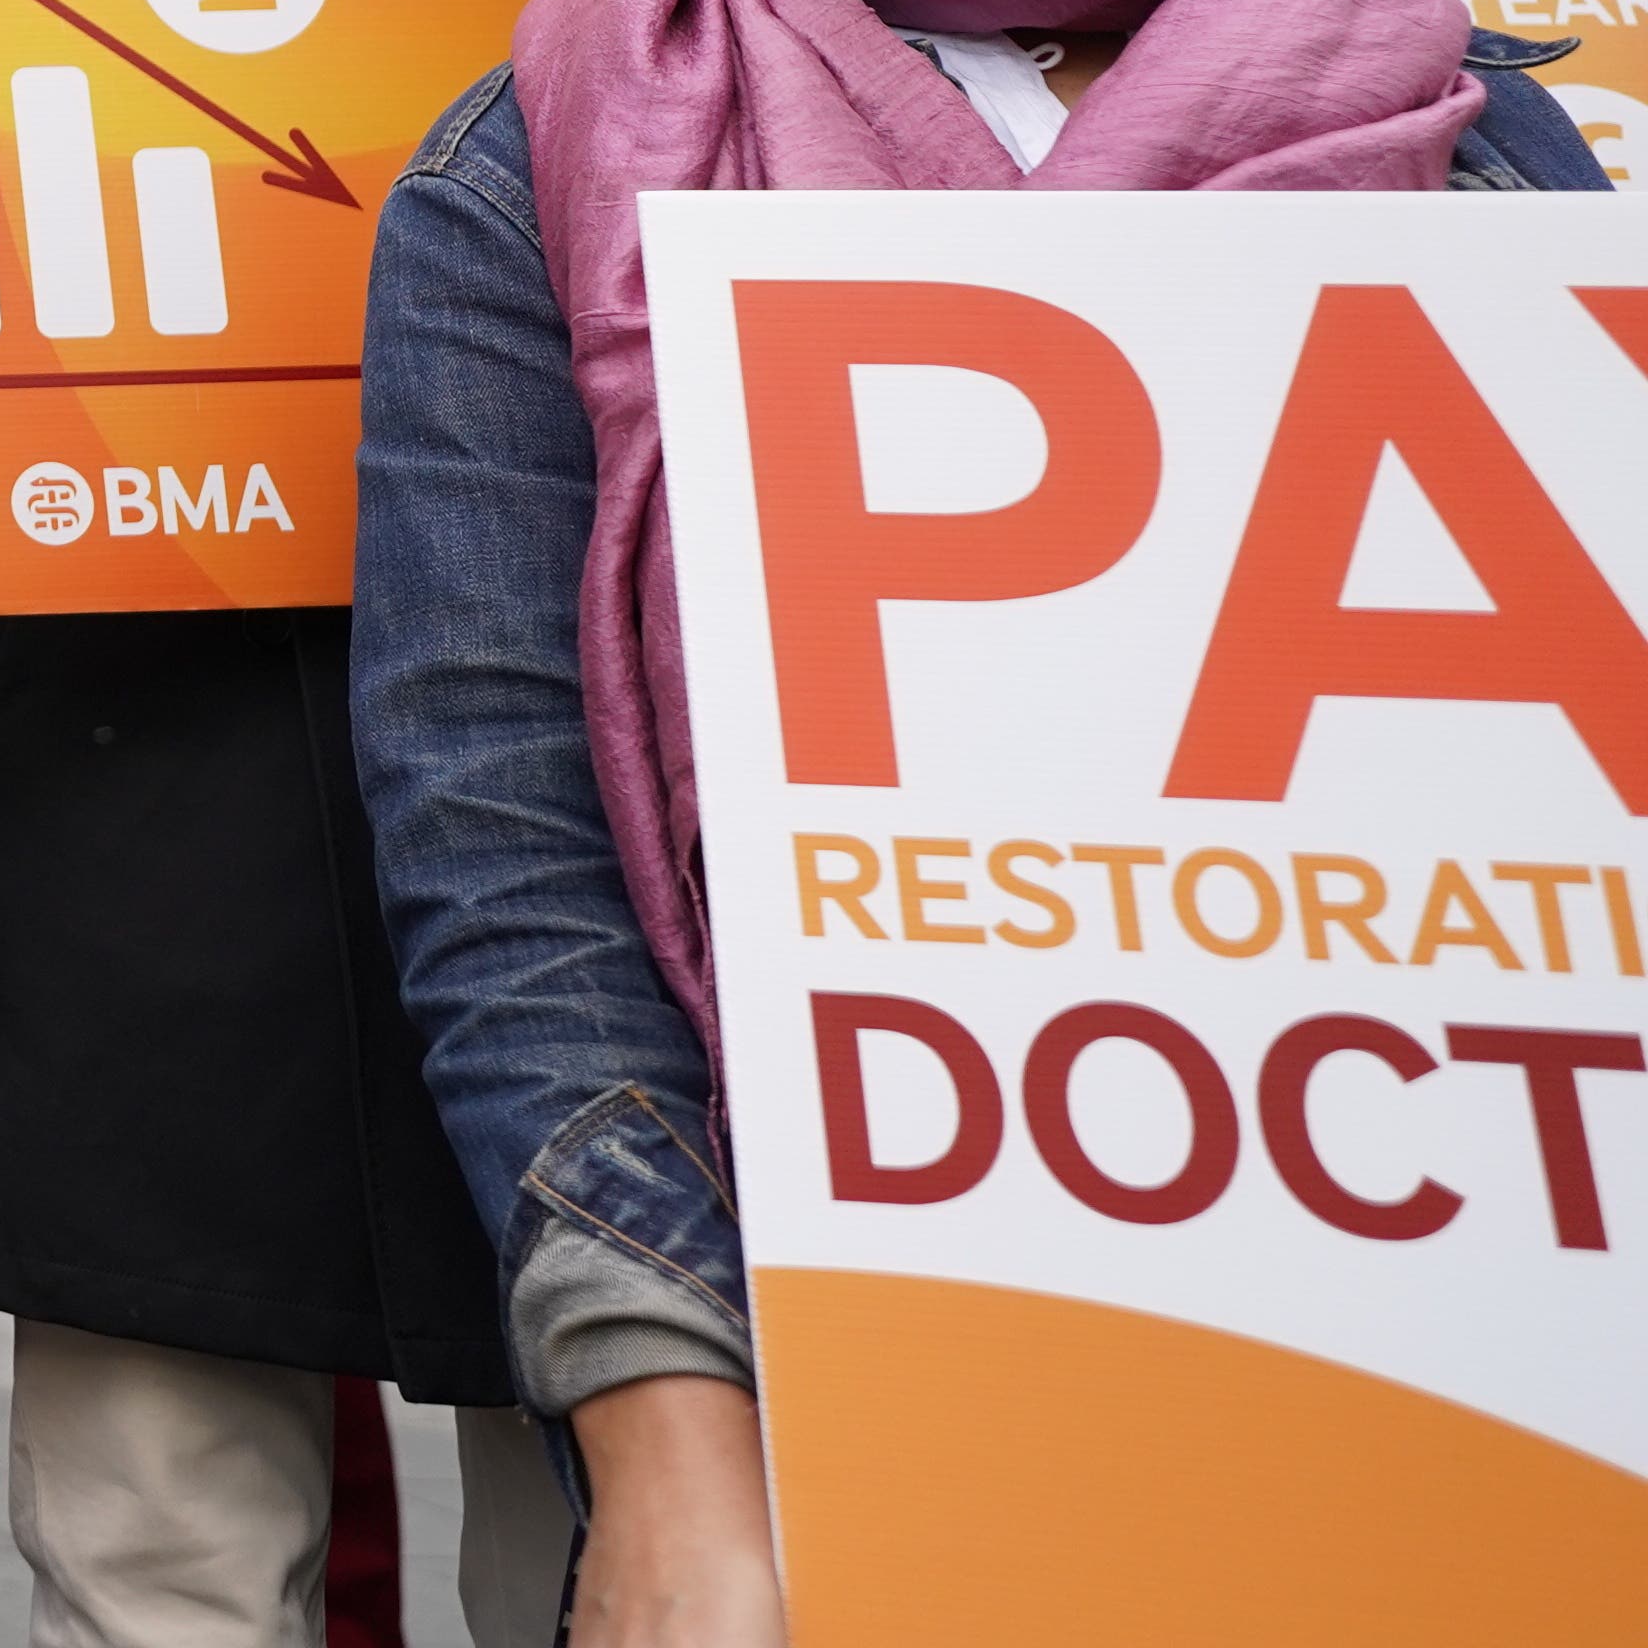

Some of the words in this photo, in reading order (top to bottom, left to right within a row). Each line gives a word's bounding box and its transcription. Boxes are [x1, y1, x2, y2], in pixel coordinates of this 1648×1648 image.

[103, 463, 295, 537] BMA
[731, 278, 1648, 818] PA
[791, 831, 1645, 977] RESTORATI
[808, 989, 1647, 1253] DOCT
